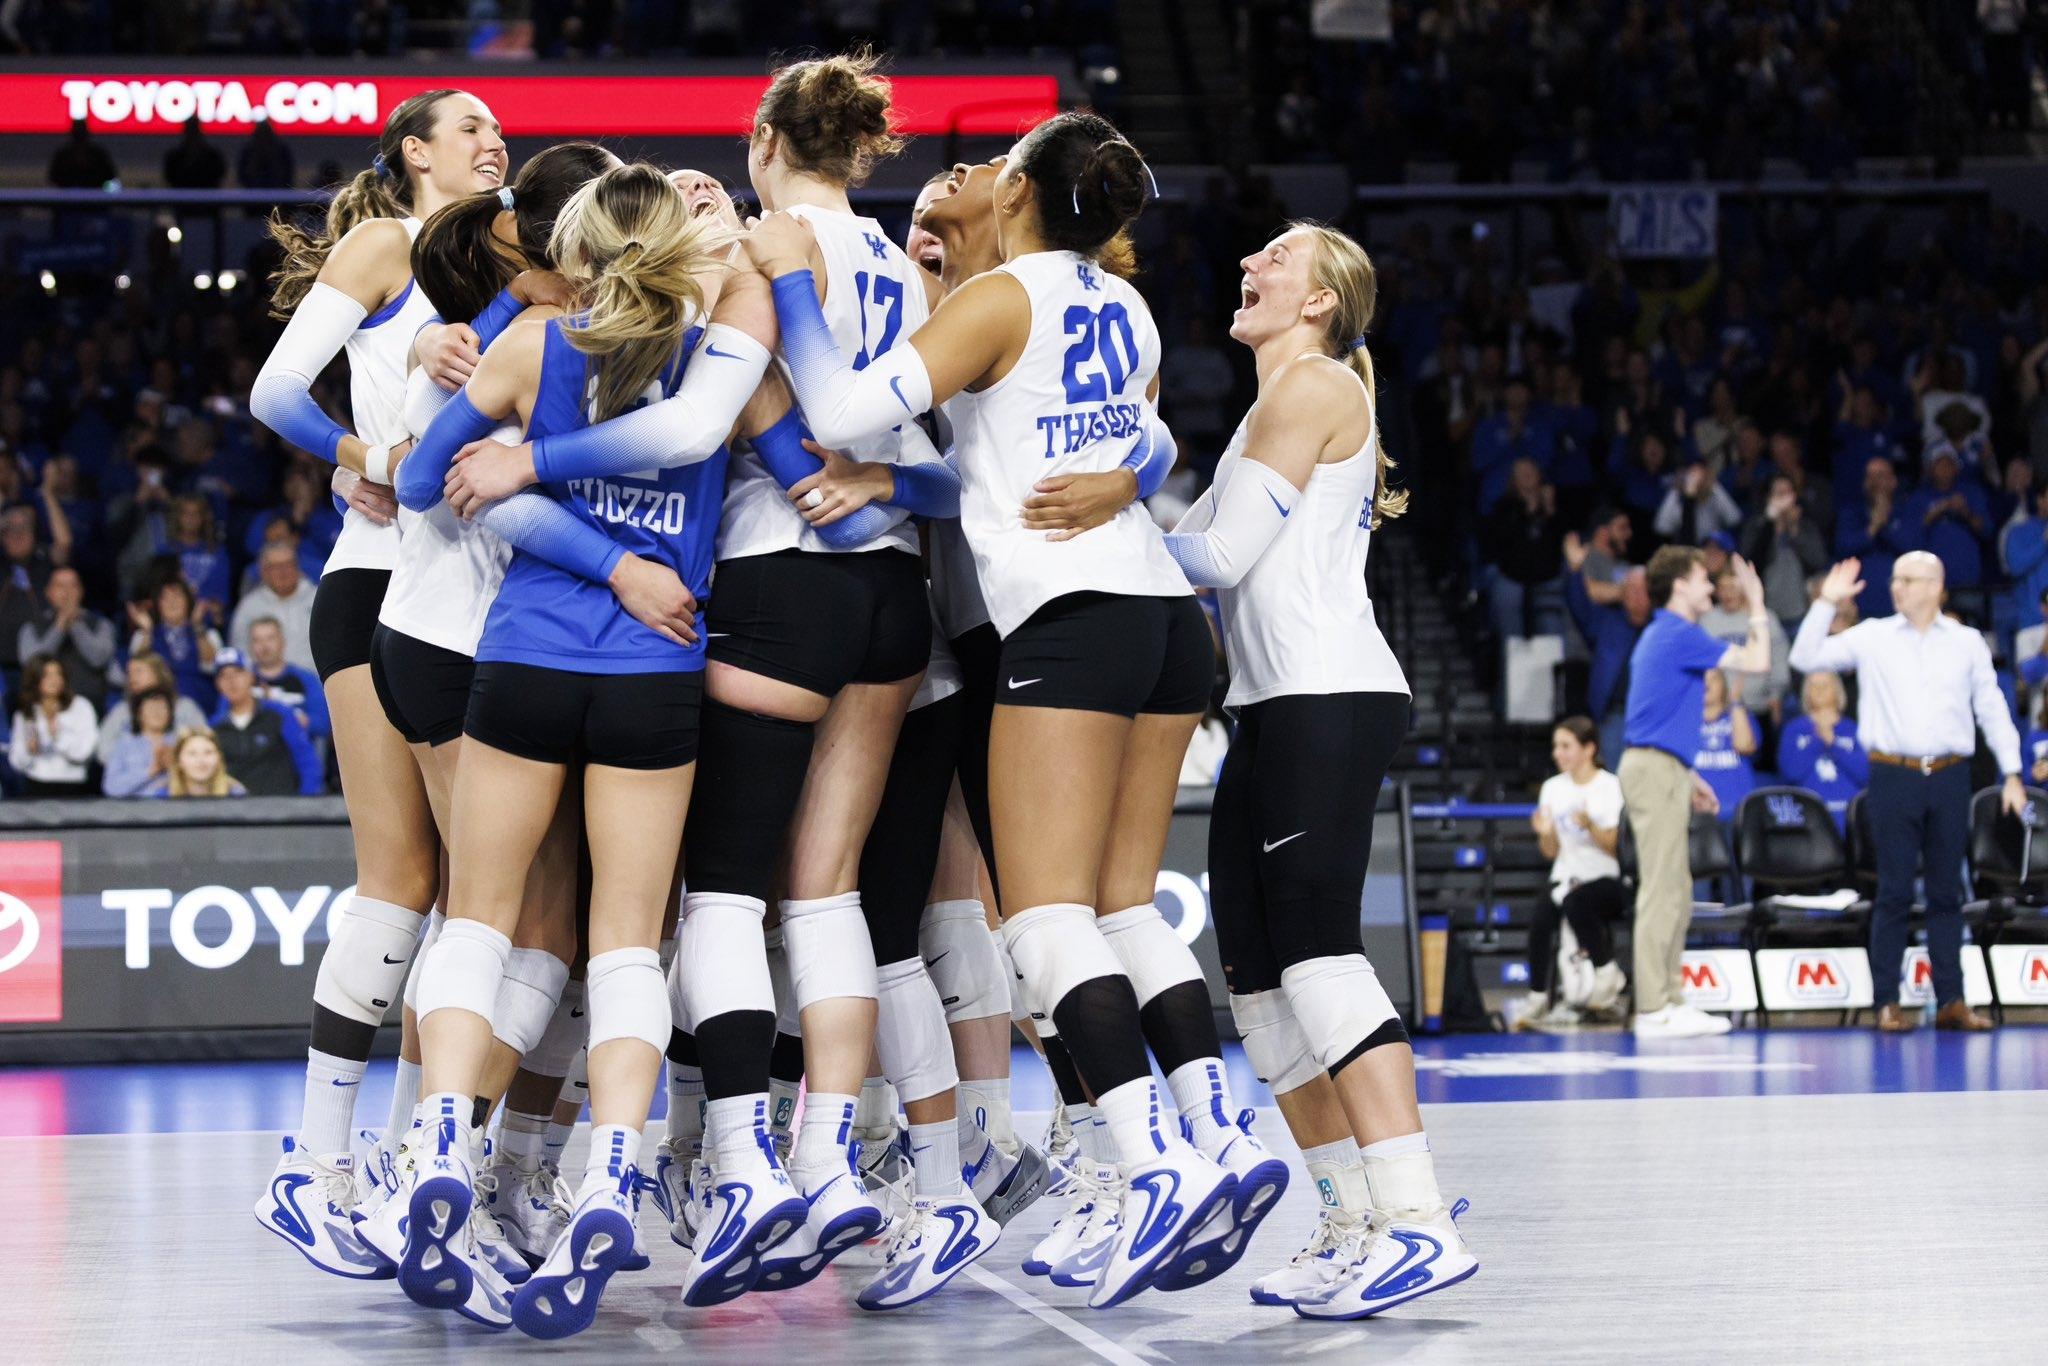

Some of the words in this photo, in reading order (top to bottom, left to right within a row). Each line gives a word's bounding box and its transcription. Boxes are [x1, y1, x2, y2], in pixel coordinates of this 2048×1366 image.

[61, 80, 378, 124] TOYOTA.COM
[852, 270, 904, 372] 17
[1062, 301, 1140, 404] 20
[335, 1158, 351, 1166] NIKE
[914, 1200, 930, 1208] NIKE
